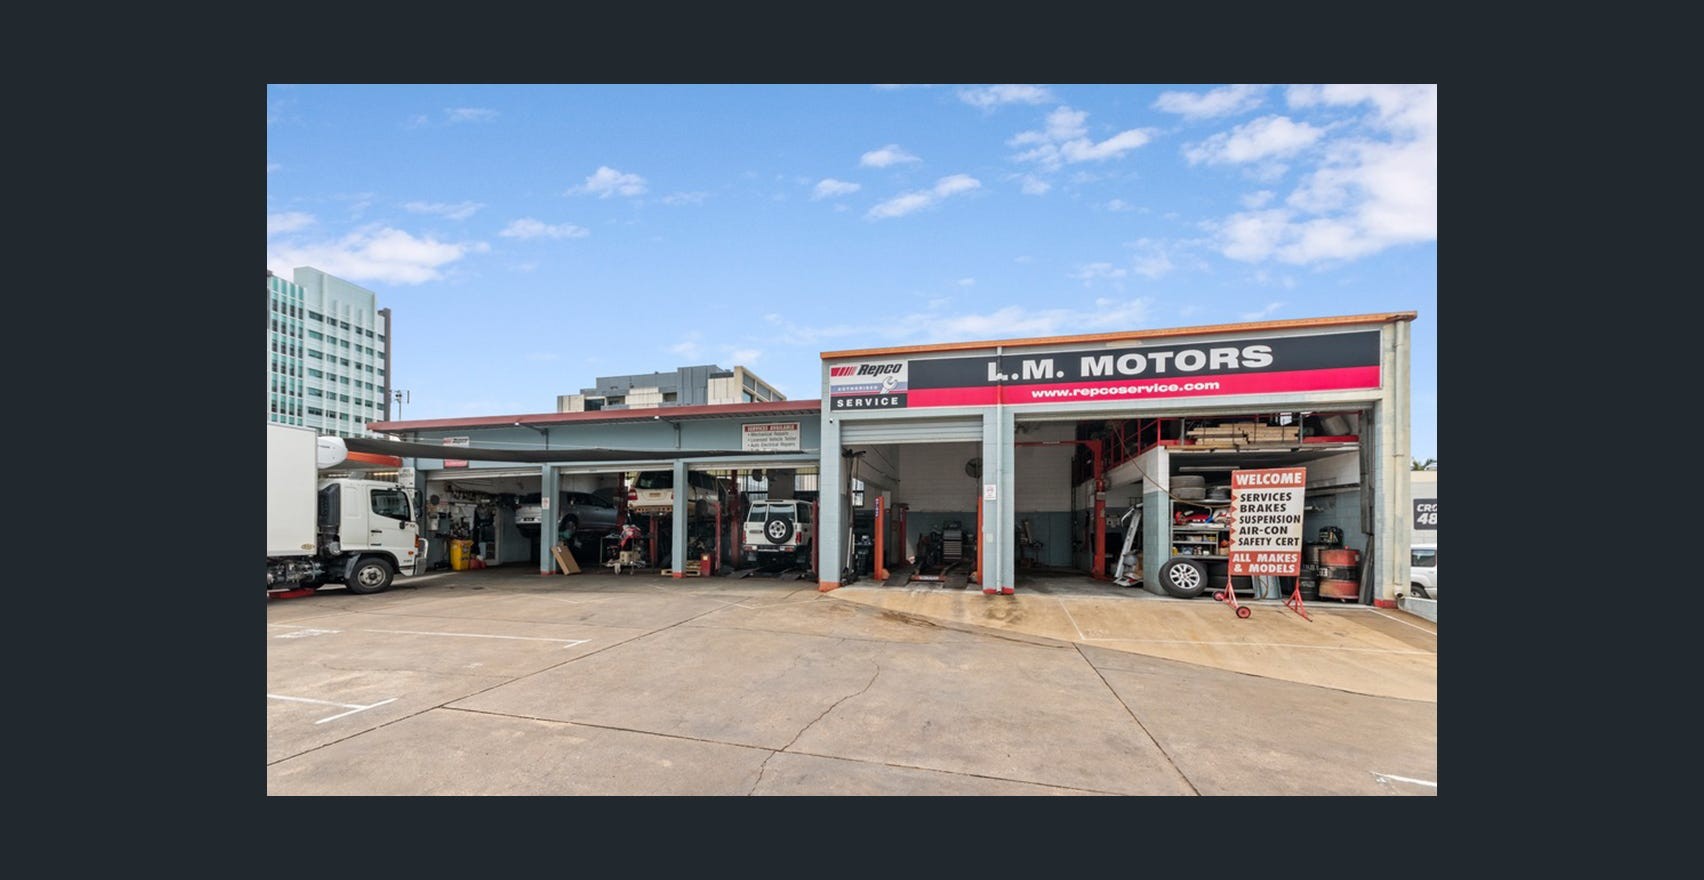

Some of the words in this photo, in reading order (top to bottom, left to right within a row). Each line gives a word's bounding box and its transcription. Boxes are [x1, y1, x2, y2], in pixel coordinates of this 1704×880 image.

[1080, 344, 1274, 377] MOTORS
[856, 363, 903, 377] Repco
[1031, 381, 1220, 398] www.repcoservice.com
[837, 397, 898, 408] SERVICE
[1236, 472, 1302, 486] WELCOME
[1240, 492, 1292, 502] SERVICES
[1240, 503, 1287, 513] BRAKES
[1239, 514, 1301, 524] SUSPENSION
[1239, 526, 1288, 535] AIR-CON
[1238, 537, 1272, 546] SAFETY
[1275, 537, 1300, 546] CERT
[1232, 553, 1251, 563] ALL
[1256, 553, 1298, 563] MAKES
[1233, 564, 1242, 573] &
[1248, 564, 1295, 573] MODELS
